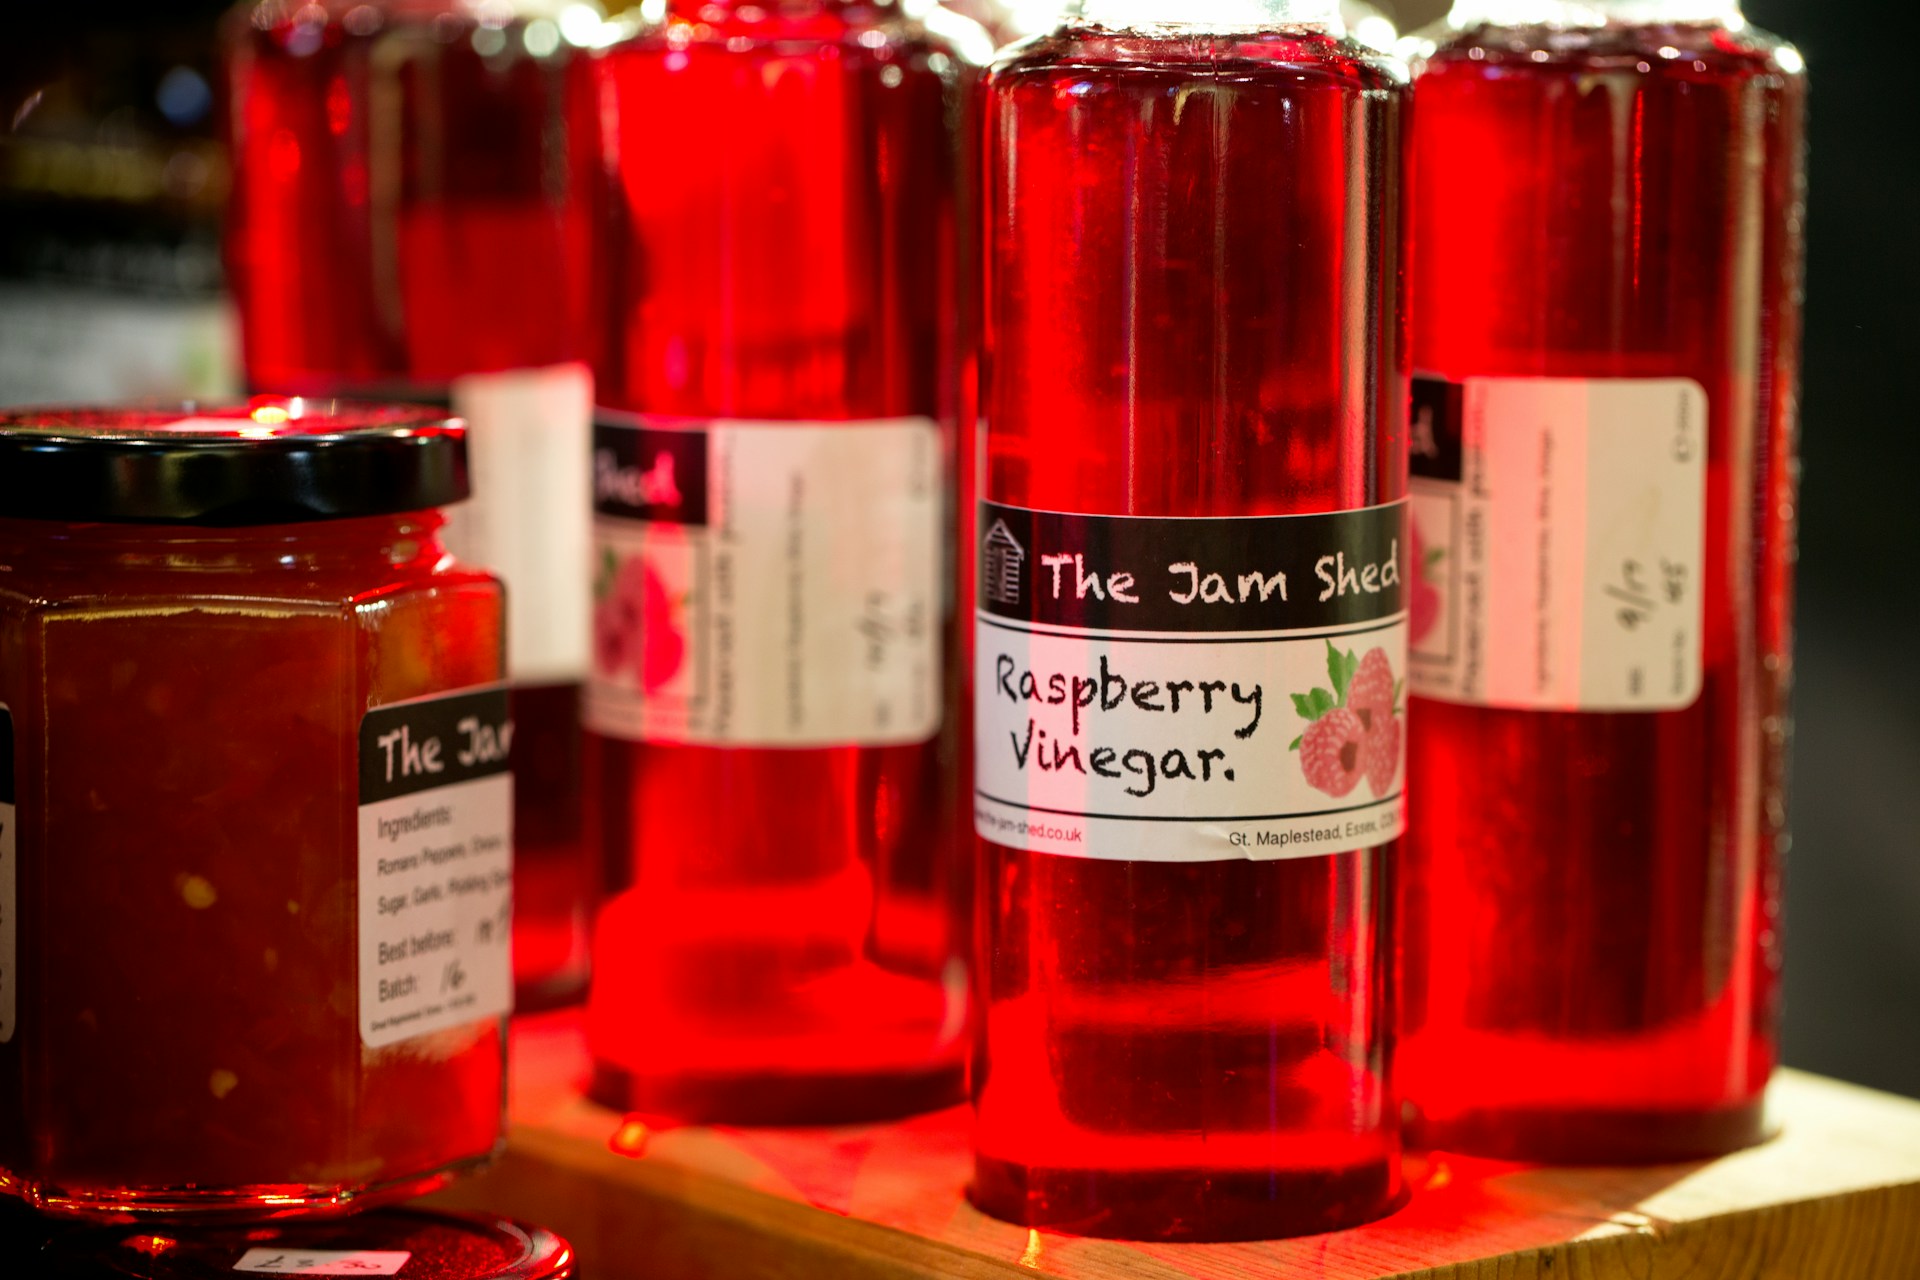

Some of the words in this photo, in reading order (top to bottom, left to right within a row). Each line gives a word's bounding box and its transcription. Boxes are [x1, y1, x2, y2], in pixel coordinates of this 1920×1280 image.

[1041, 553, 1140, 604] The
[1167, 561, 1288, 605] Jam
[1313, 539, 1401, 603] Shed
[995, 654, 1264, 740] Raspberry
[377, 723, 445, 783] The
[1010, 718, 1236, 798] Vinegar.
[1229, 831, 1251, 847] Gt.
[1256, 824, 1343, 848] Maplestead,
[378, 938, 409, 966] Best
